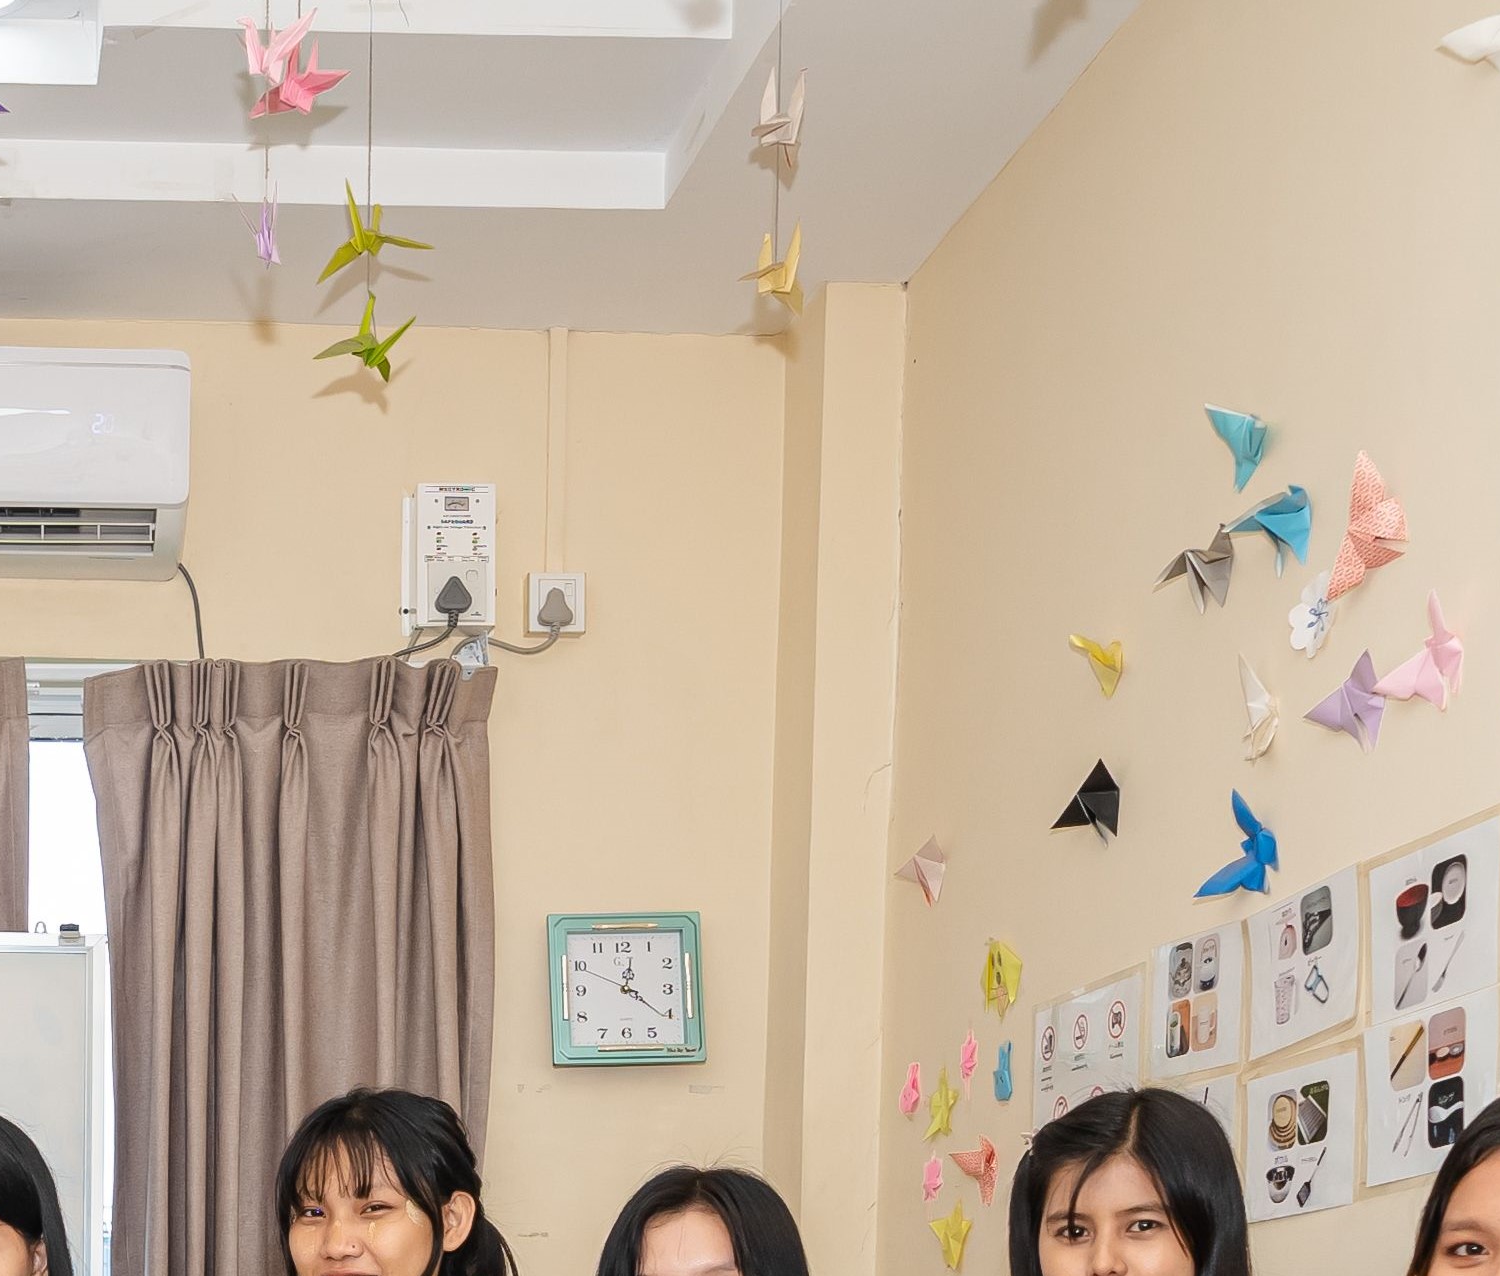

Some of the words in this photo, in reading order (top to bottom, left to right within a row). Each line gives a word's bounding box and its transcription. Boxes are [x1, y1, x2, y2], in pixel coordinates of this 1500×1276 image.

[593, 942, 603, 954] 11
[615, 941, 632, 954] 12
[647, 941, 651, 952] 1
[574, 960, 587, 972] 10
[662, 957, 673, 970] 2
[575, 985, 587, 997] 9
[662, 983, 674, 995] 3
[576, 1011, 588, 1023] 8
[663, 1008, 673, 1020] 4
[597, 1028, 608, 1040] 7
[621, 1027, 633, 1039] 6
[647, 1027, 658, 1039] 5
